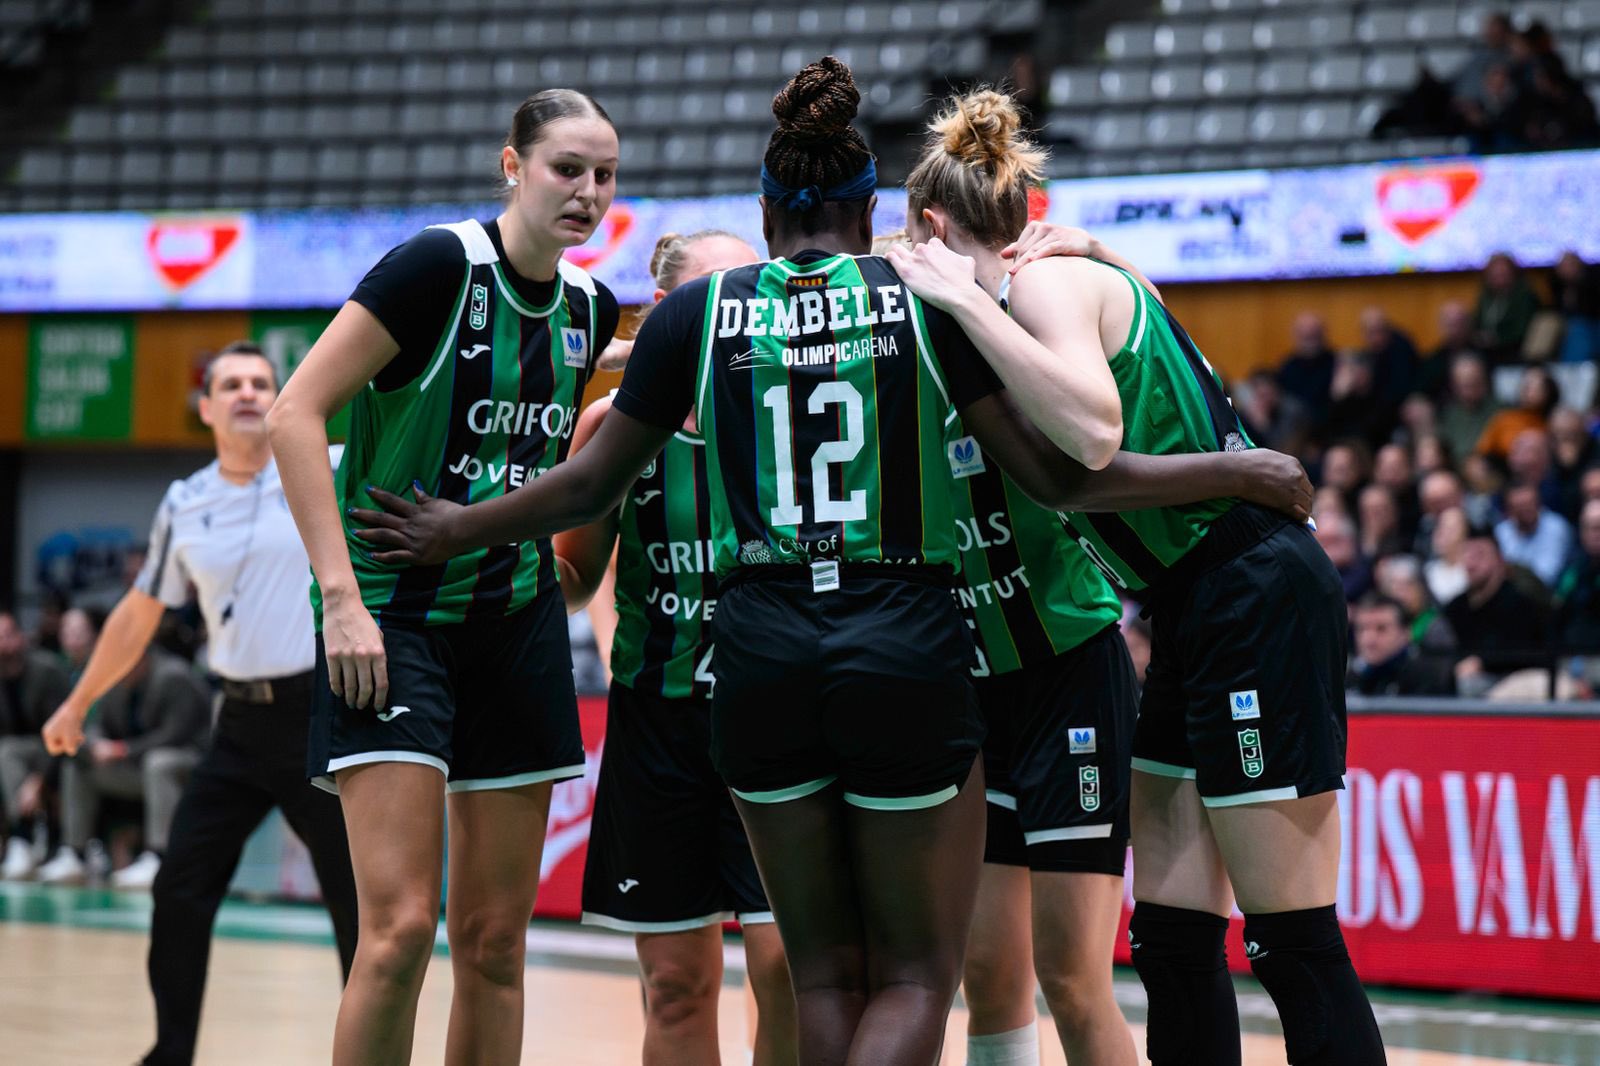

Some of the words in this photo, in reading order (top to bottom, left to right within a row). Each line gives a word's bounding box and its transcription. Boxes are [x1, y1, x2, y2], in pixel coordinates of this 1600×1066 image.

[718, 284, 906, 339] DEMBELE
[763, 380, 867, 526] 12
[779, 536, 809, 556] City
[817, 535, 838, 552] of
[951, 565, 1031, 609] NTUT
